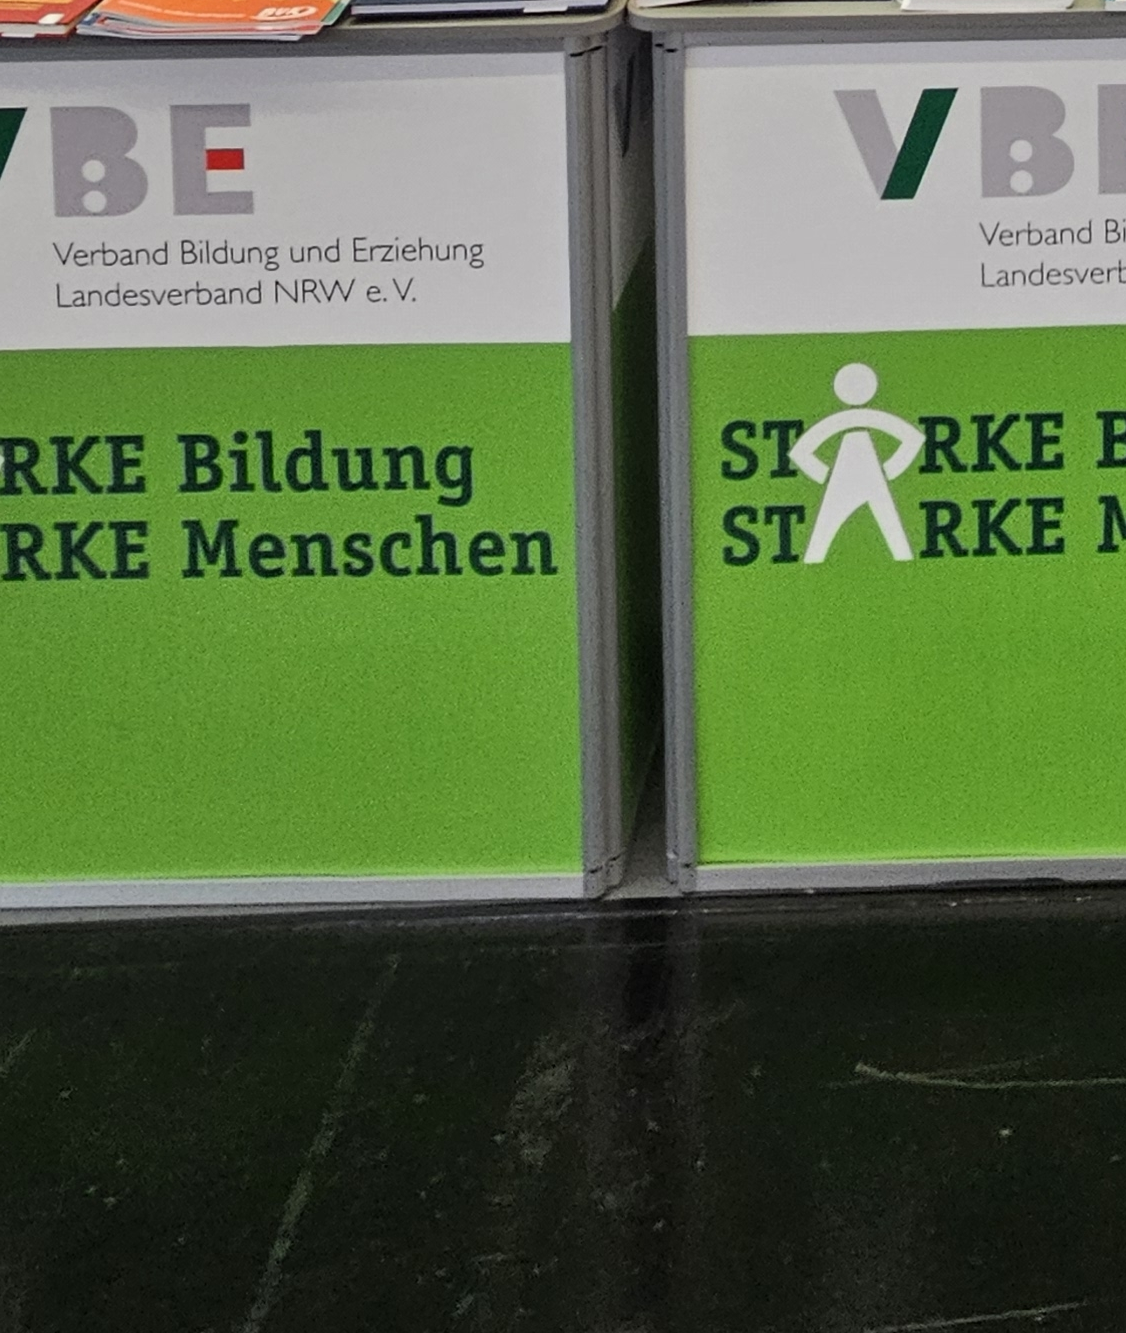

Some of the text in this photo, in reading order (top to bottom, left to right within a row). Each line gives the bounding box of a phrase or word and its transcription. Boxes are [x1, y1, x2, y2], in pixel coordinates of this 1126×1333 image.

[0, 103, 255, 218] BE
[53, 236, 486, 272] Verband Bildung und Erziehung
[979, 217, 1093, 247] Verband
[55, 280, 264, 309] Landesverband
[274, 278, 356, 305] NRW
[178, 429, 475, 508] Bildung
[182, 513, 559, 580] Menschen
